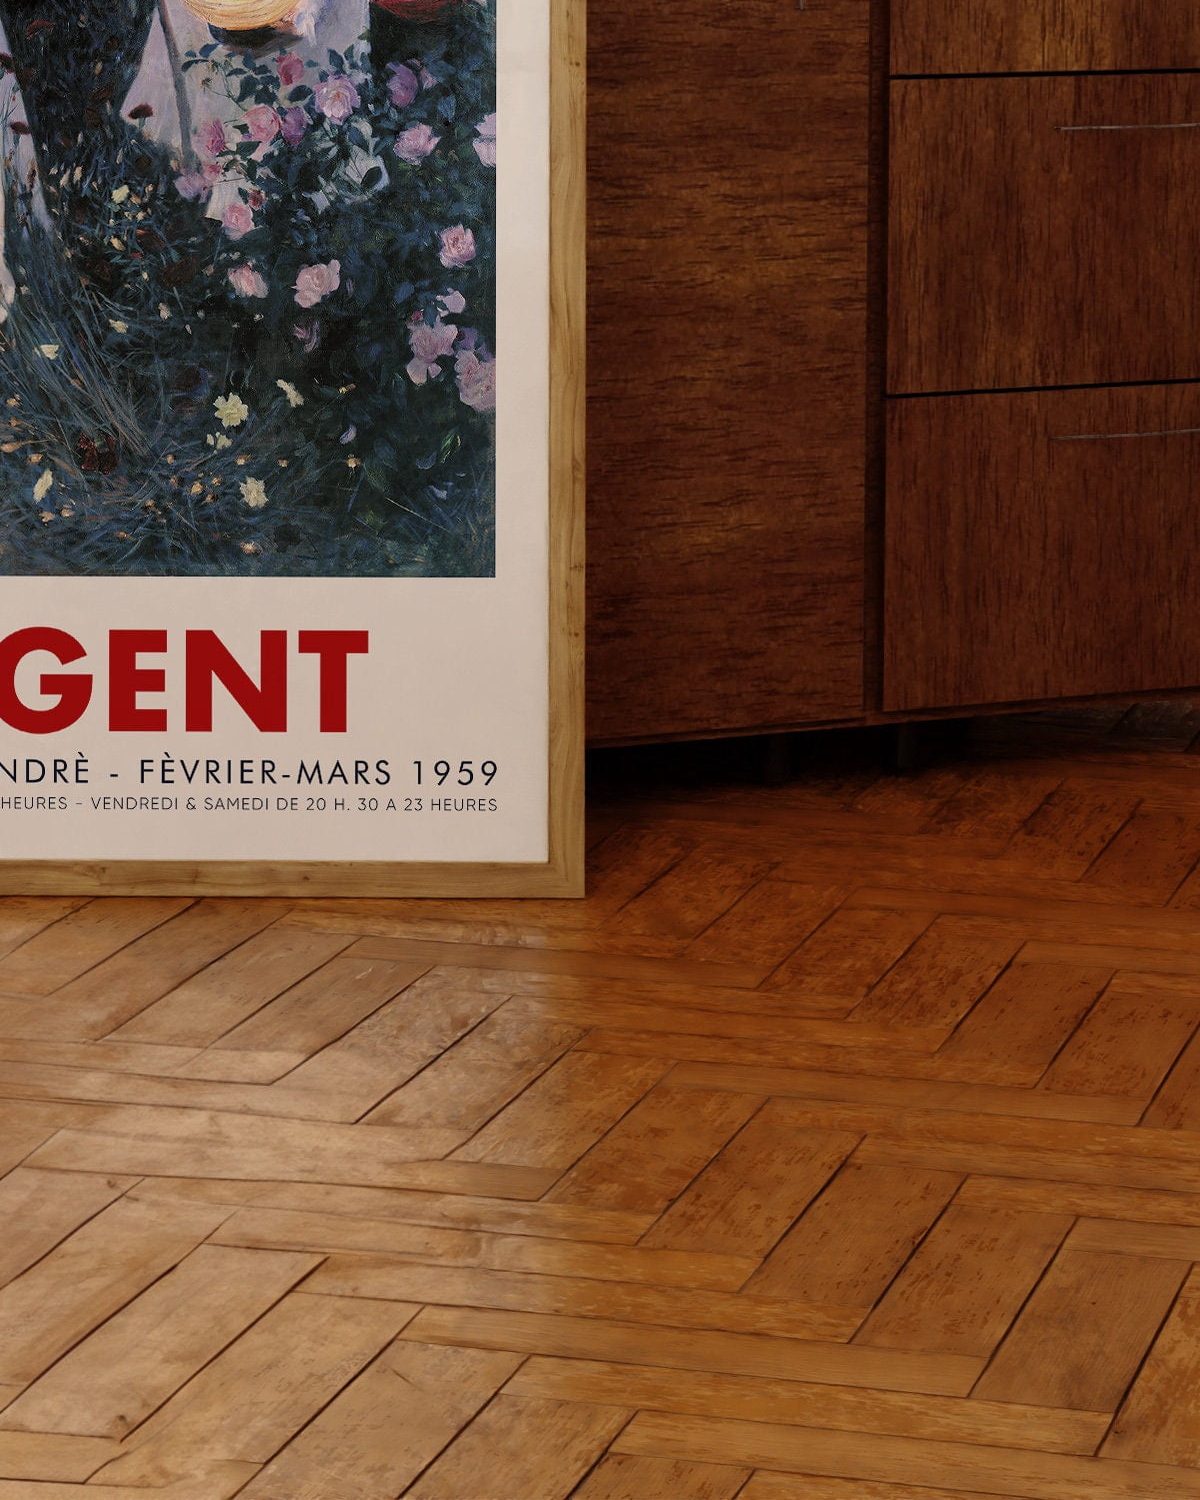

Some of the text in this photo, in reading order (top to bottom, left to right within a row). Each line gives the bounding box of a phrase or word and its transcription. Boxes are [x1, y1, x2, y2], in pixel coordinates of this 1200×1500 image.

[141, 752, 391, 786] FÈVRIER-MARS
[413, 760, 498, 786] 1959
[2, 797, 67, 810] HEURES
[91, 797, 177, 810] VENDREDI
[186, 797, 196, 810] &
[204, 797, 268, 810] SAMEDI
[277, 798, 298, 810] DE
[307, 798, 326, 811] 20
[335, 798, 349, 811] H.
[358, 798, 378, 811] 30
[386, 798, 396, 811] A
[404, 798, 423, 811] 23
[431, 798, 498, 811] HEURES
